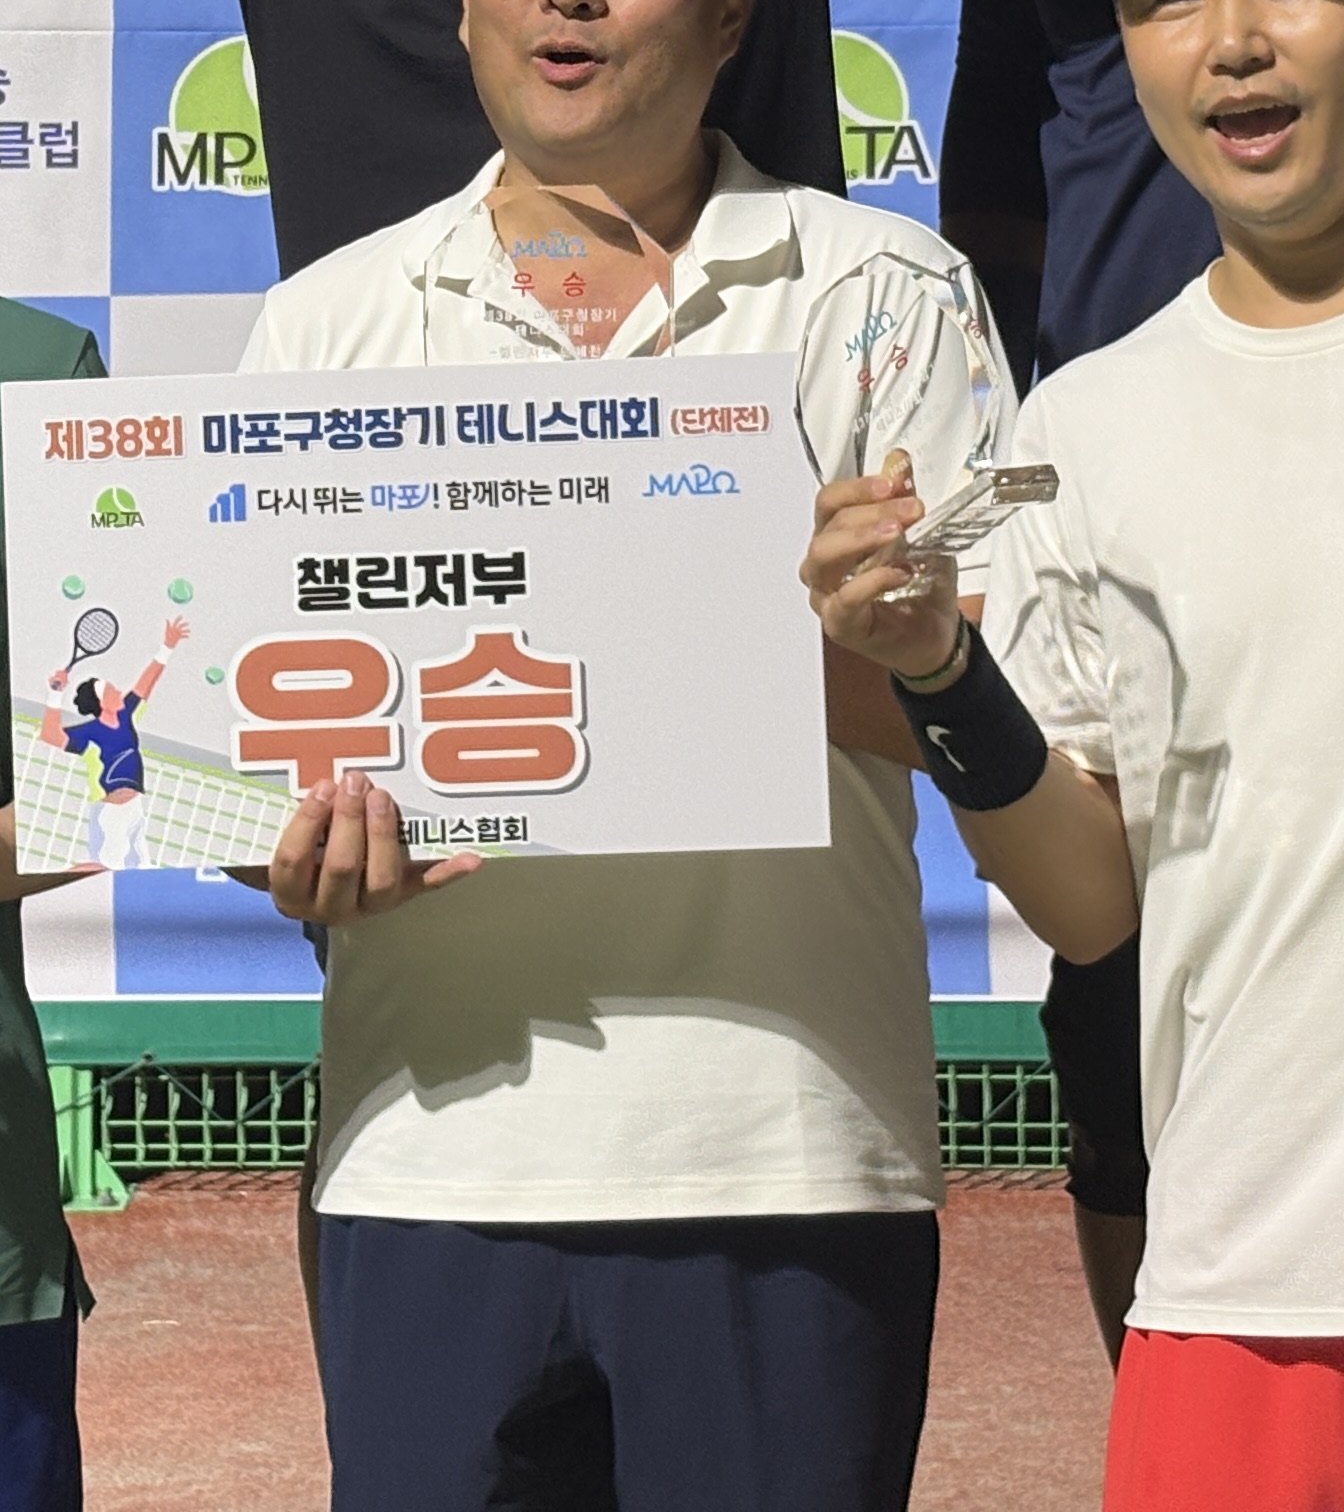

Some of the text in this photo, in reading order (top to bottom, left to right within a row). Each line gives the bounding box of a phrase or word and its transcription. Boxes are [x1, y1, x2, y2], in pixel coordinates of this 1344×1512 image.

[44, 397, 770, 461] 제38회 마포구청장기 테니스대회 (단체전)
[257, 487, 309, 516] 다시
[313, 486, 365, 516] 뛰는
[446, 478, 553, 511] 함께하는
[558, 476, 610, 506] 미래
[298, 551, 527, 612] 챌린저부
[235, 631, 577, 790] 우승
